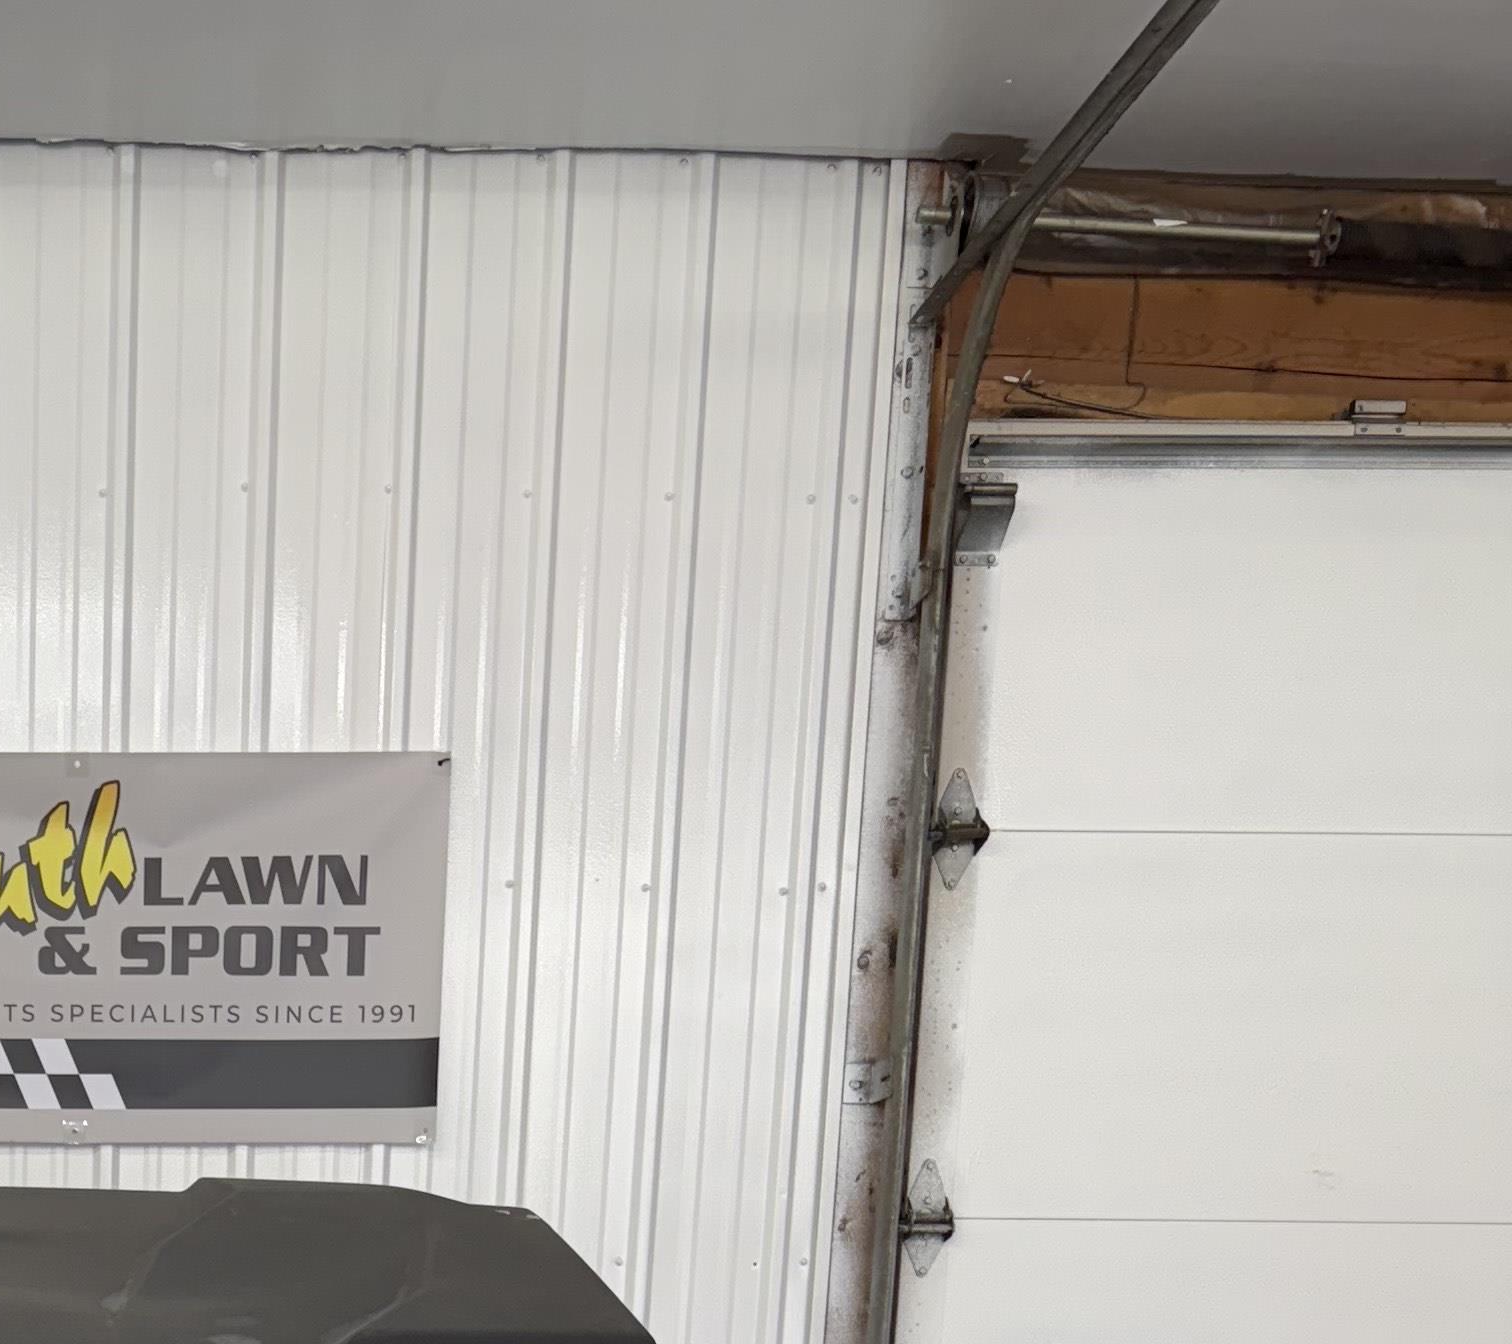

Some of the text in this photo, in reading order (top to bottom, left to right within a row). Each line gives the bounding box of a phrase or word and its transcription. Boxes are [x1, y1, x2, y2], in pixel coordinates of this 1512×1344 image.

[144, 853, 369, 907] LAWN
[37, 925, 381, 978] & SPORT
[49, 1003, 241, 1024] SPECIALISTS
[254, 1004, 344, 1024] SINCE
[357, 1004, 417, 1024] 1991
